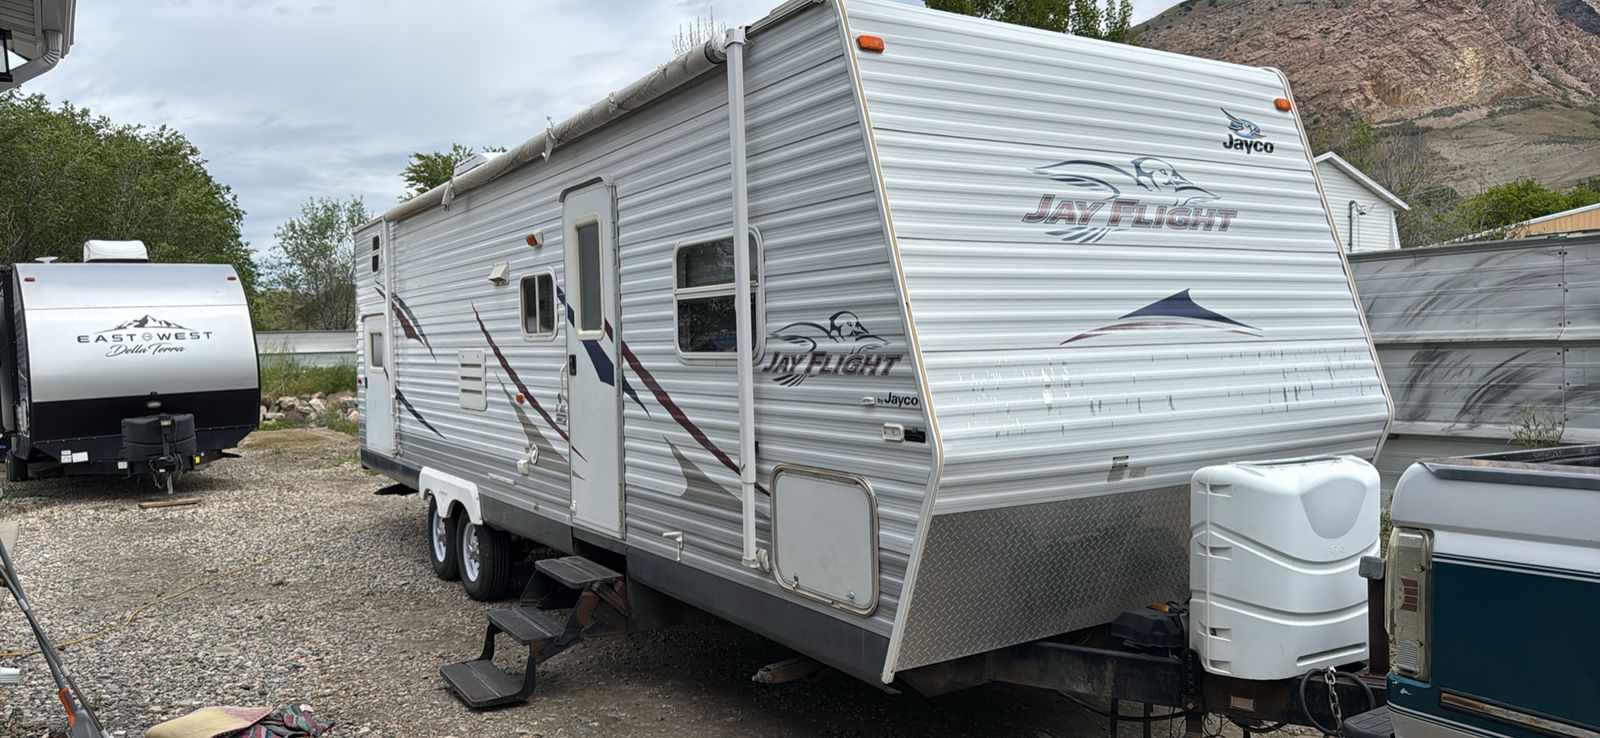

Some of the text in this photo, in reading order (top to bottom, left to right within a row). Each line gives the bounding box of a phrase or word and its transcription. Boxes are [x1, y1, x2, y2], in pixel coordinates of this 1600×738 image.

[1222, 133, 1274, 154] Jayco
[1022, 194, 1238, 231] JAY FLIGHT
[77, 331, 213, 343] EAST WEST
[105, 342, 186, 357] Della Terra
[762, 351, 903, 376] JAY FLIGHT
[884, 392, 919, 407] Jayco
